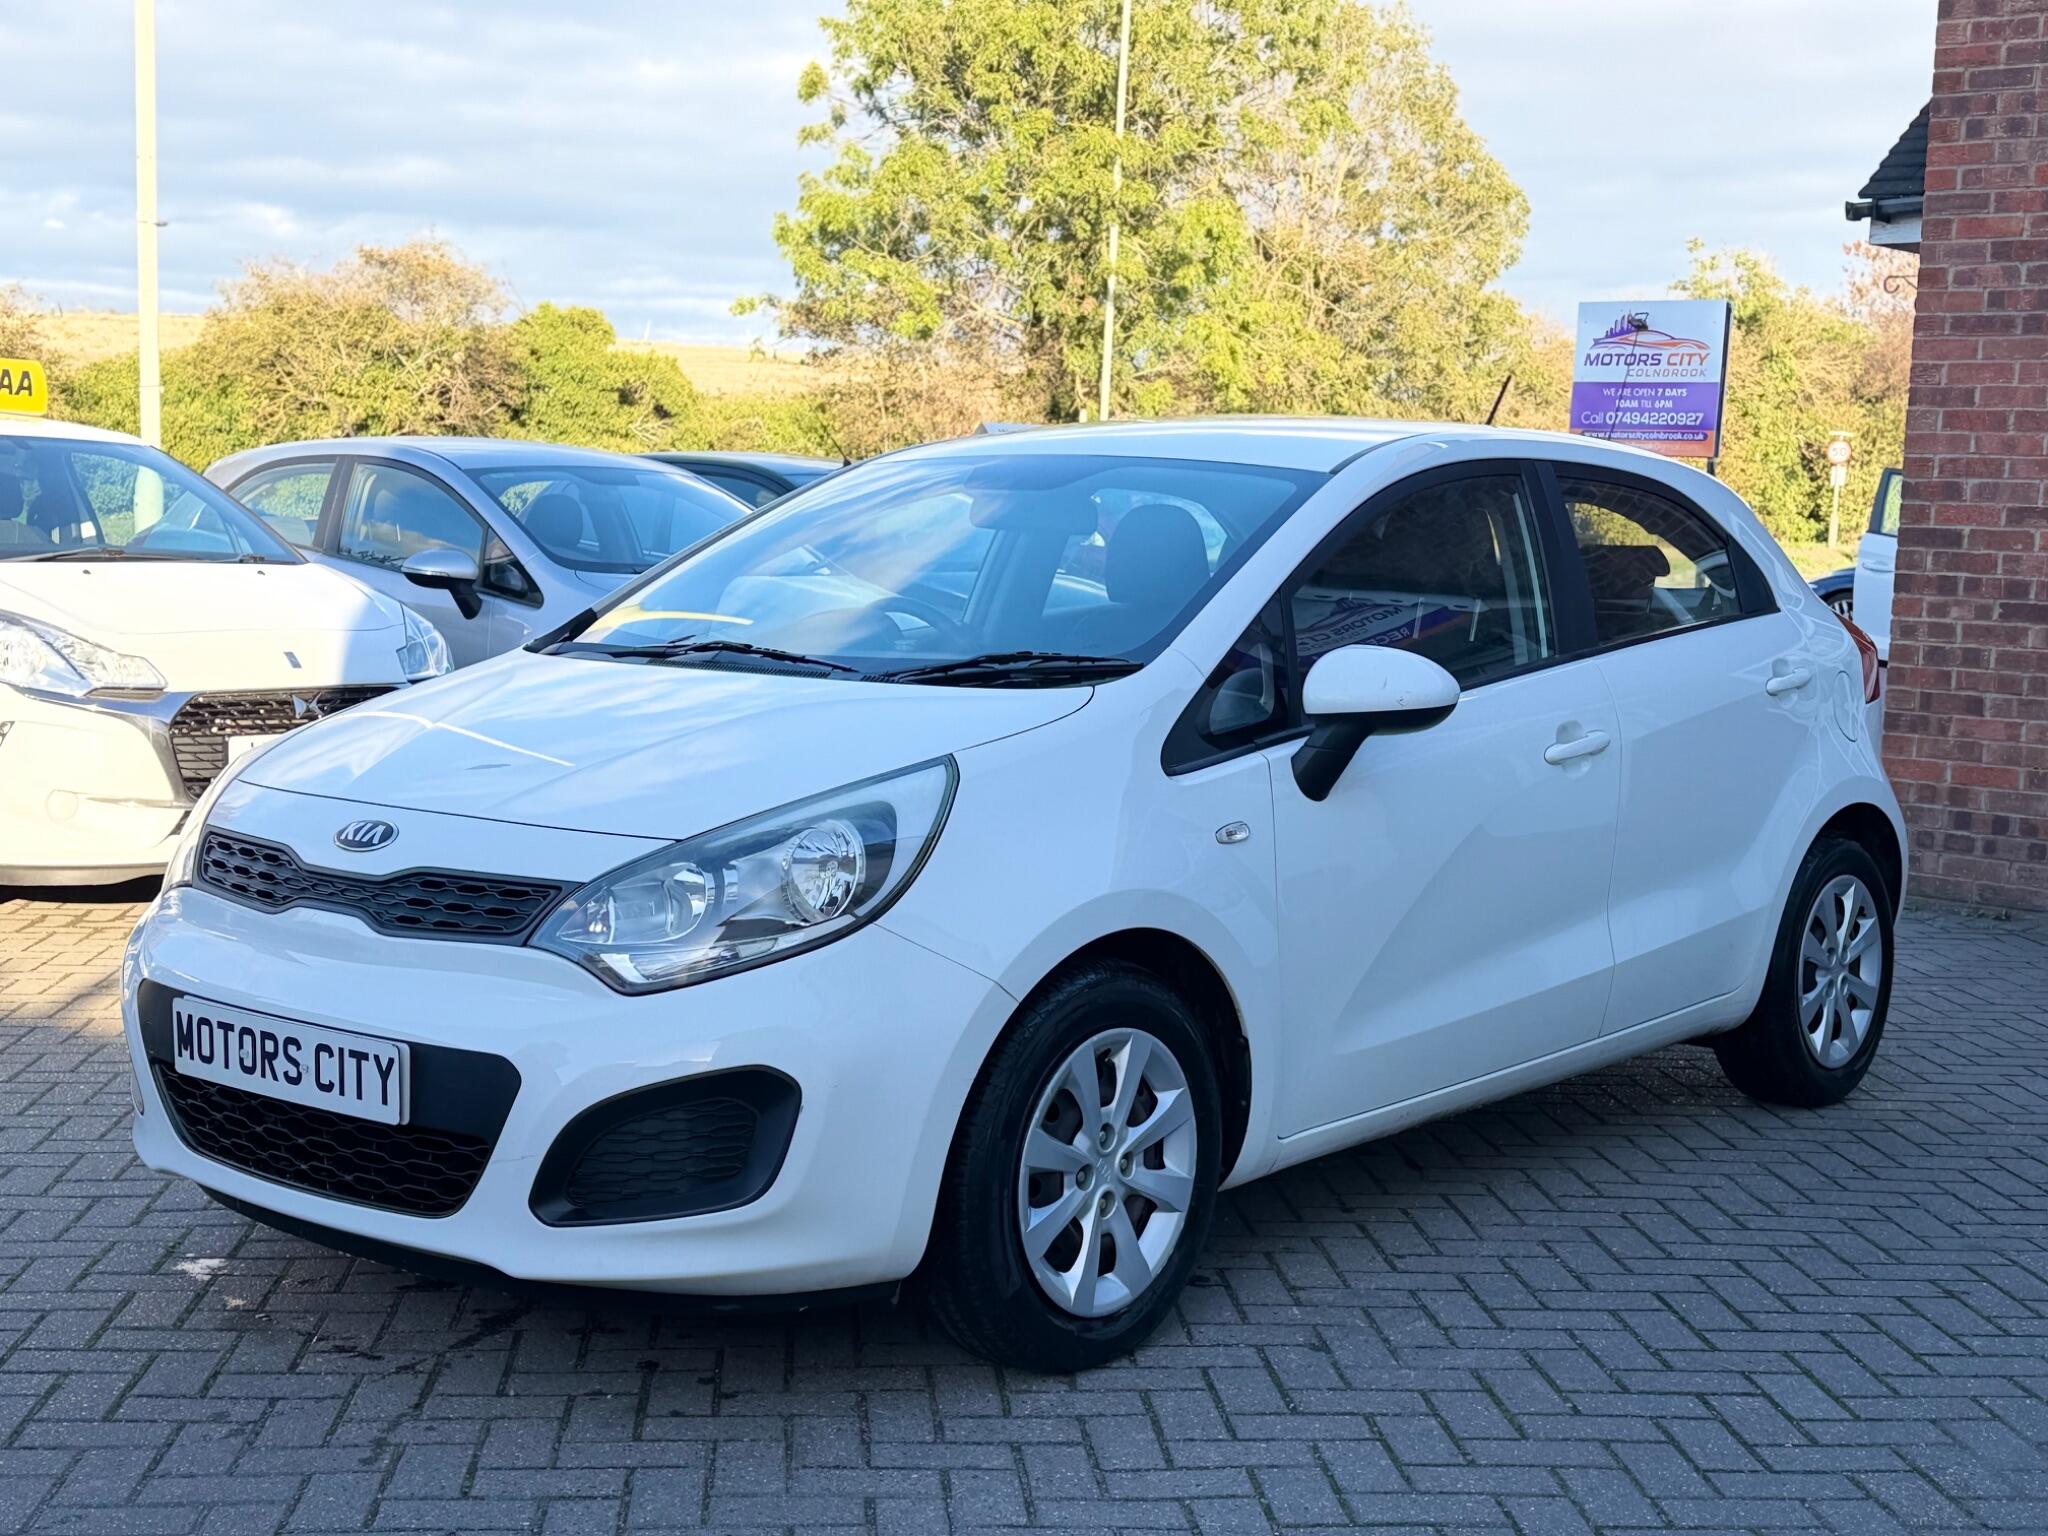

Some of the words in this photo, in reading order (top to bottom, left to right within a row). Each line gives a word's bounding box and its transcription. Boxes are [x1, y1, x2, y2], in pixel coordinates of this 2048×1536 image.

[1584, 353, 1662, 366] MOTORS
[1666, 353, 1710, 366] CITY
[1628, 368, 1706, 378] COLNBROOK
[1603, 388, 1615, 396] WE
[1633, 388, 1656, 397] OPEN
[1657, 388, 1664, 397] 7
[1665, 388, 1688, 397] DAYS
[1654, 400, 1673, 408] 6PM
[1581, 411, 1603, 425] Call
[1605, 412, 1704, 426] 07494220927
[340, 822, 387, 844] KIA
[175, 1010, 303, 1087] MOTORS
[314, 1042, 396, 1106] CITY
